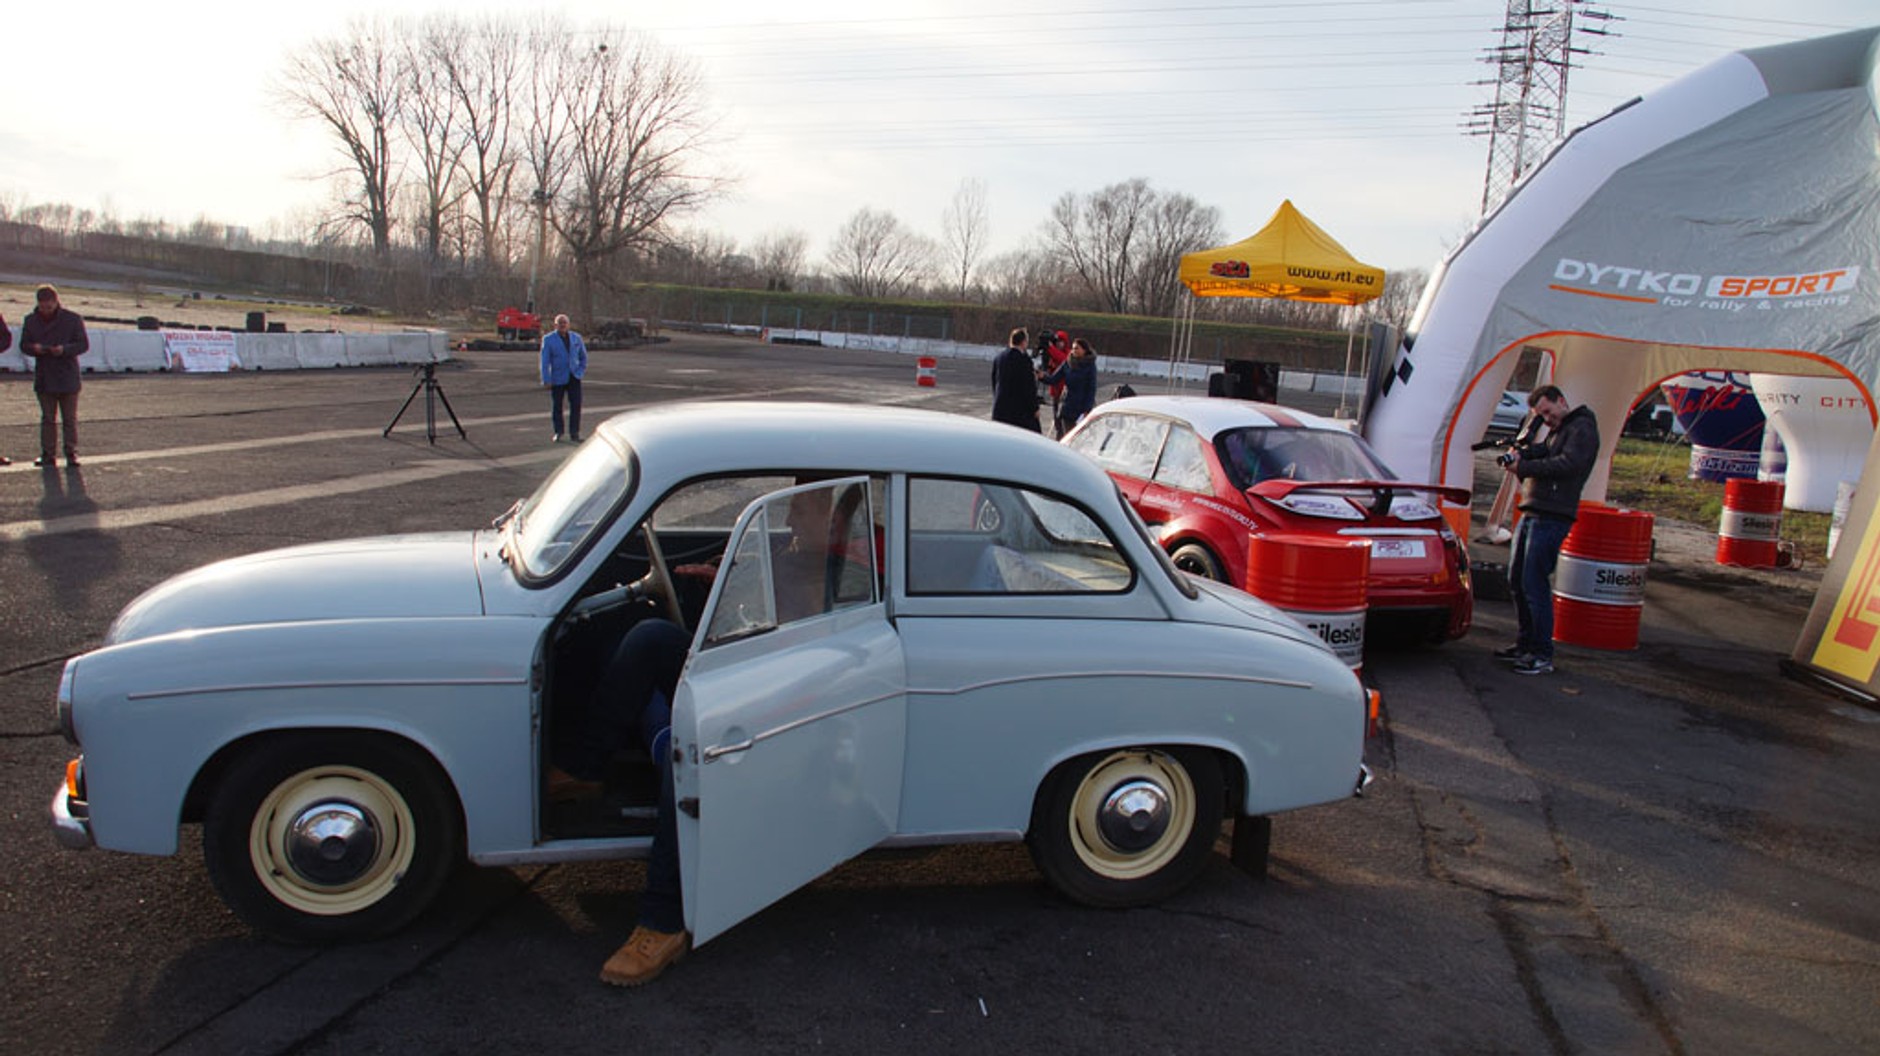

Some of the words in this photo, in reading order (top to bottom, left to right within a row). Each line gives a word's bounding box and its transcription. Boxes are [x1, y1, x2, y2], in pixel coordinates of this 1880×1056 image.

[1554, 258, 1702, 296] DYTKO
[1718, 271, 1847, 298] SPORT
[1662, 296, 1692, 307] for
[1699, 300, 1748, 312] rally
[1757, 301, 1772, 311] &
[1784, 294, 1850, 310] racing
[1595, 568, 1641, 586] Silesia
